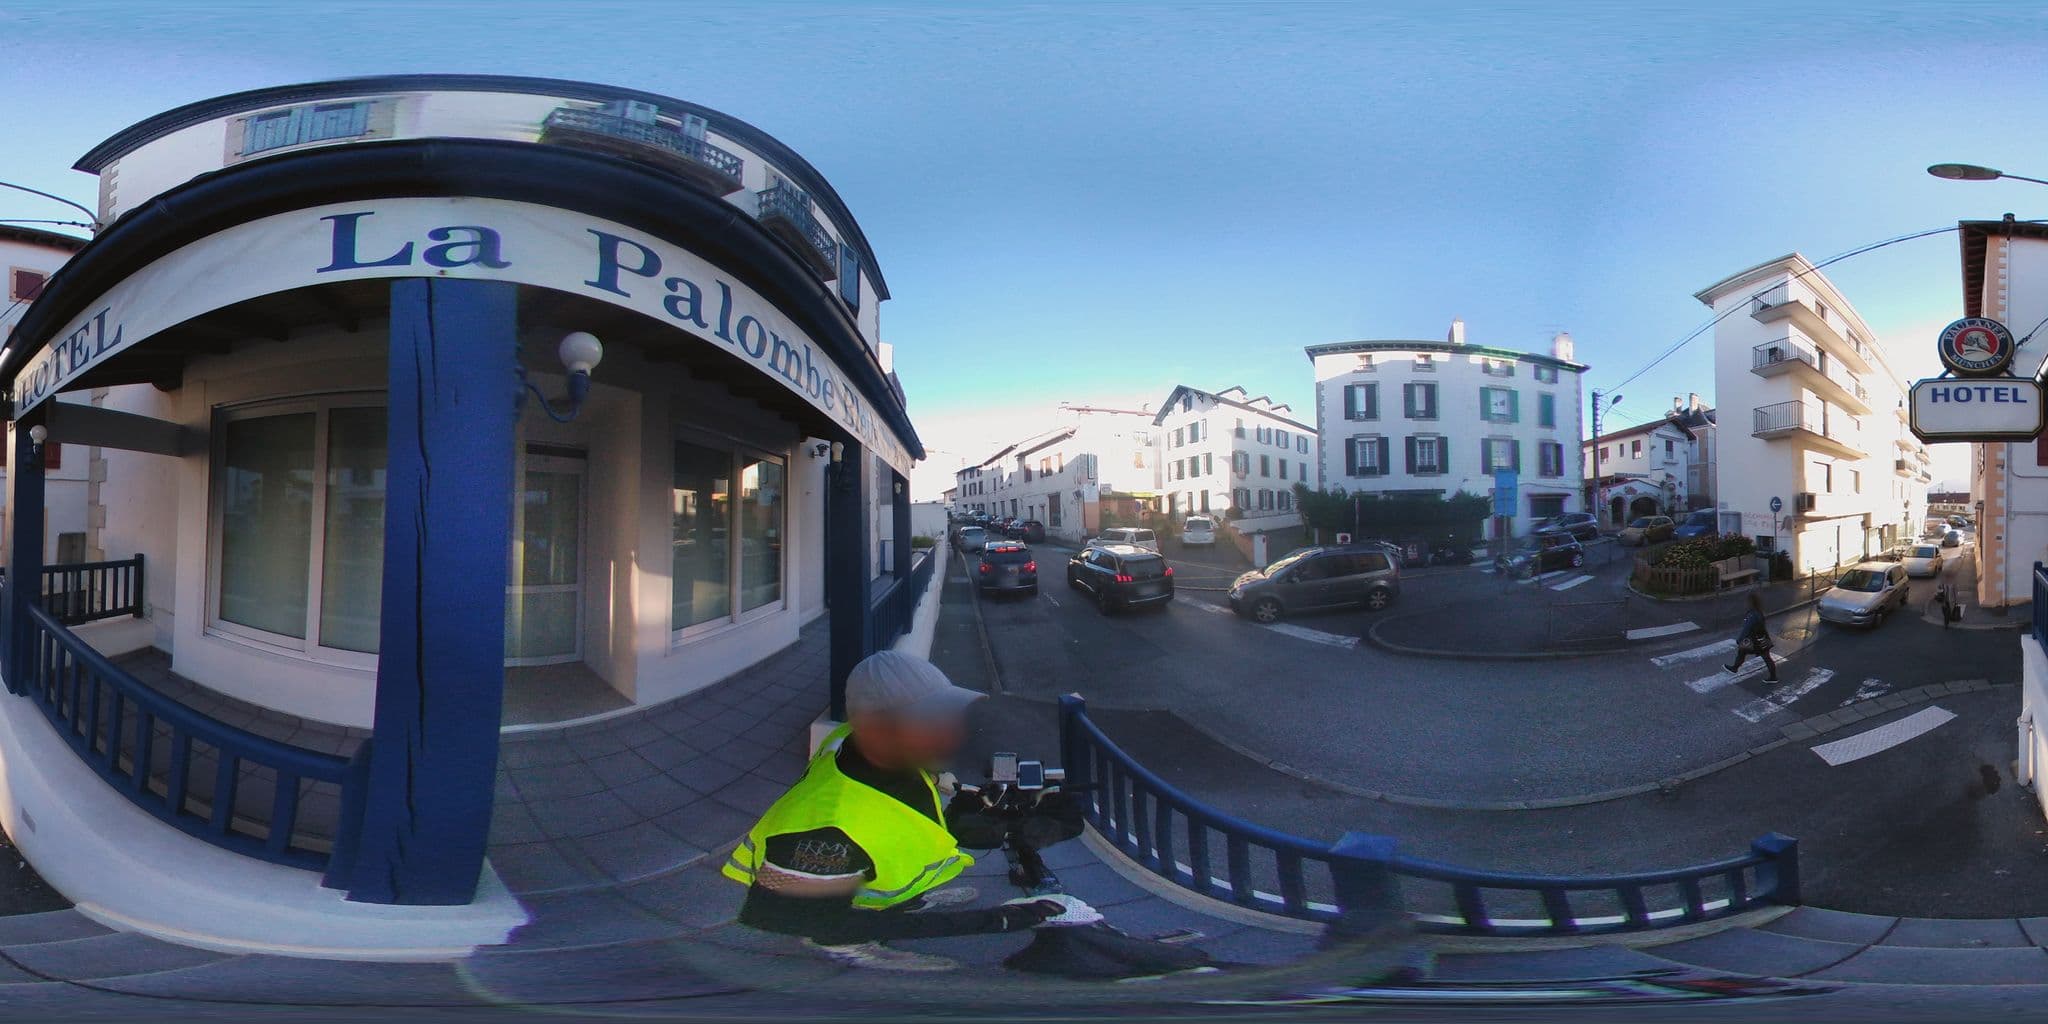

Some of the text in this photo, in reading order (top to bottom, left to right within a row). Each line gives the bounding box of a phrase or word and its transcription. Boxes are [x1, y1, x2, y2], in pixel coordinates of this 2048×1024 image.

[316, 211, 512, 273] La
[584, 228, 836, 412] Palombe
[1946, 319, 2005, 340] PAULANER
[21, 306, 122, 411] HOTEL
[1931, 387, 2027, 403] HOTEL
